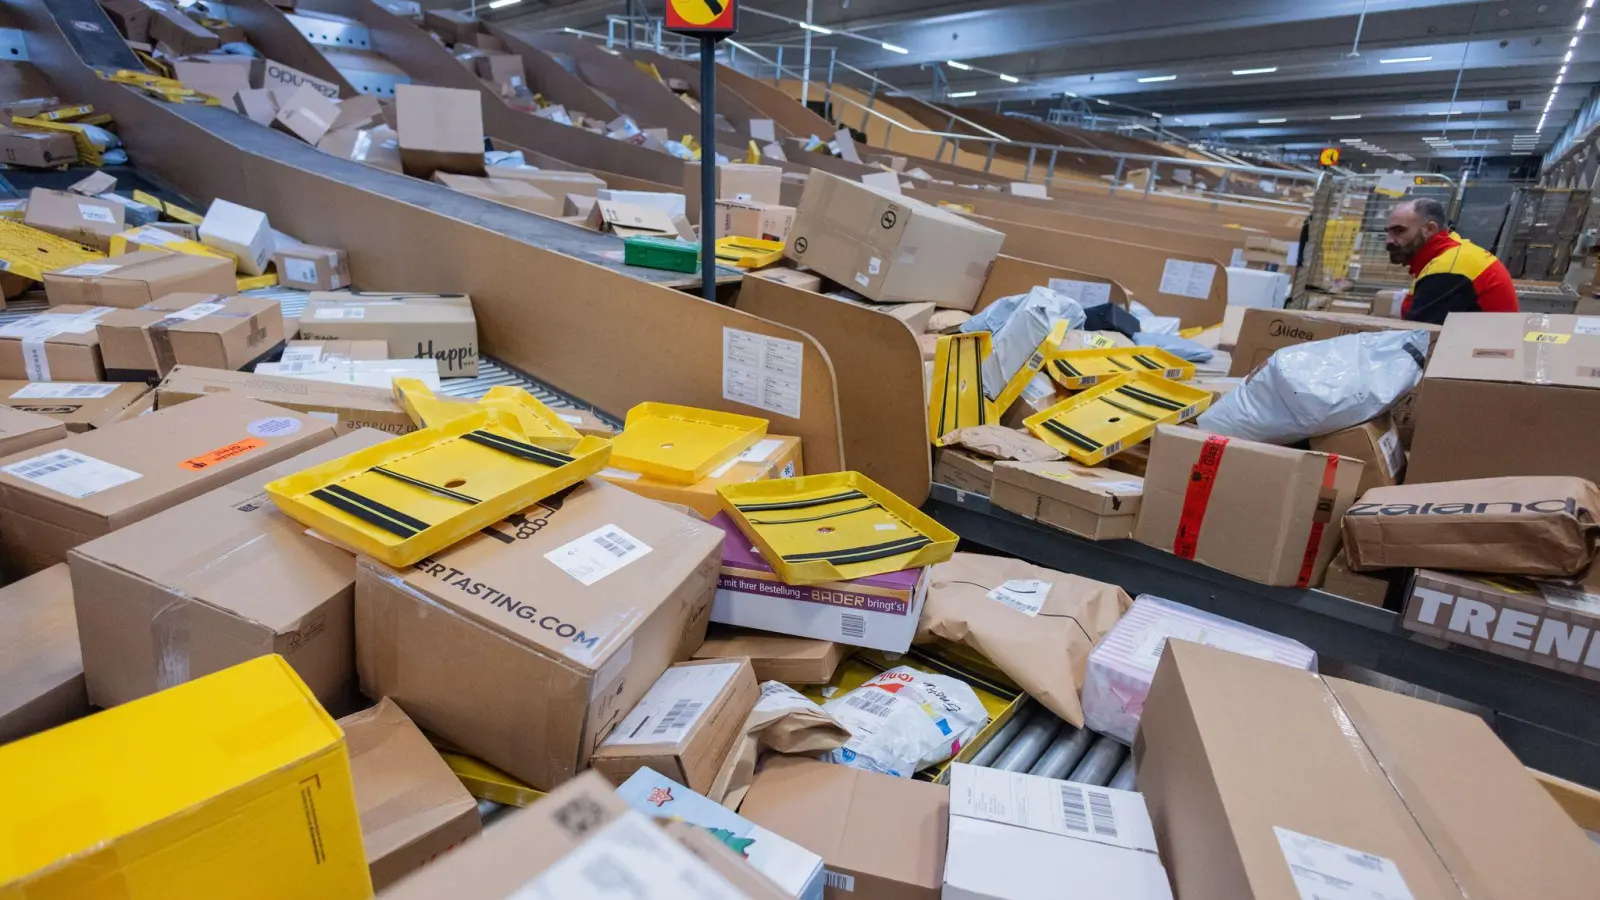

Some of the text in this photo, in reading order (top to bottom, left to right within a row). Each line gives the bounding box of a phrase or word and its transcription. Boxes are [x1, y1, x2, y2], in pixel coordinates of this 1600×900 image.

[1268, 319, 1314, 341] Midea
[414, 340, 479, 371] Happi
[413, 558, 600, 650] ERTASTING.COM
[724, 579, 738, 588] mit
[740, 580, 757, 590] Ihrer
[760, 583, 800, 599] Bestellung
[811, 590, 865, 607] BADER
[868, 598, 905, 612] bringt's!
